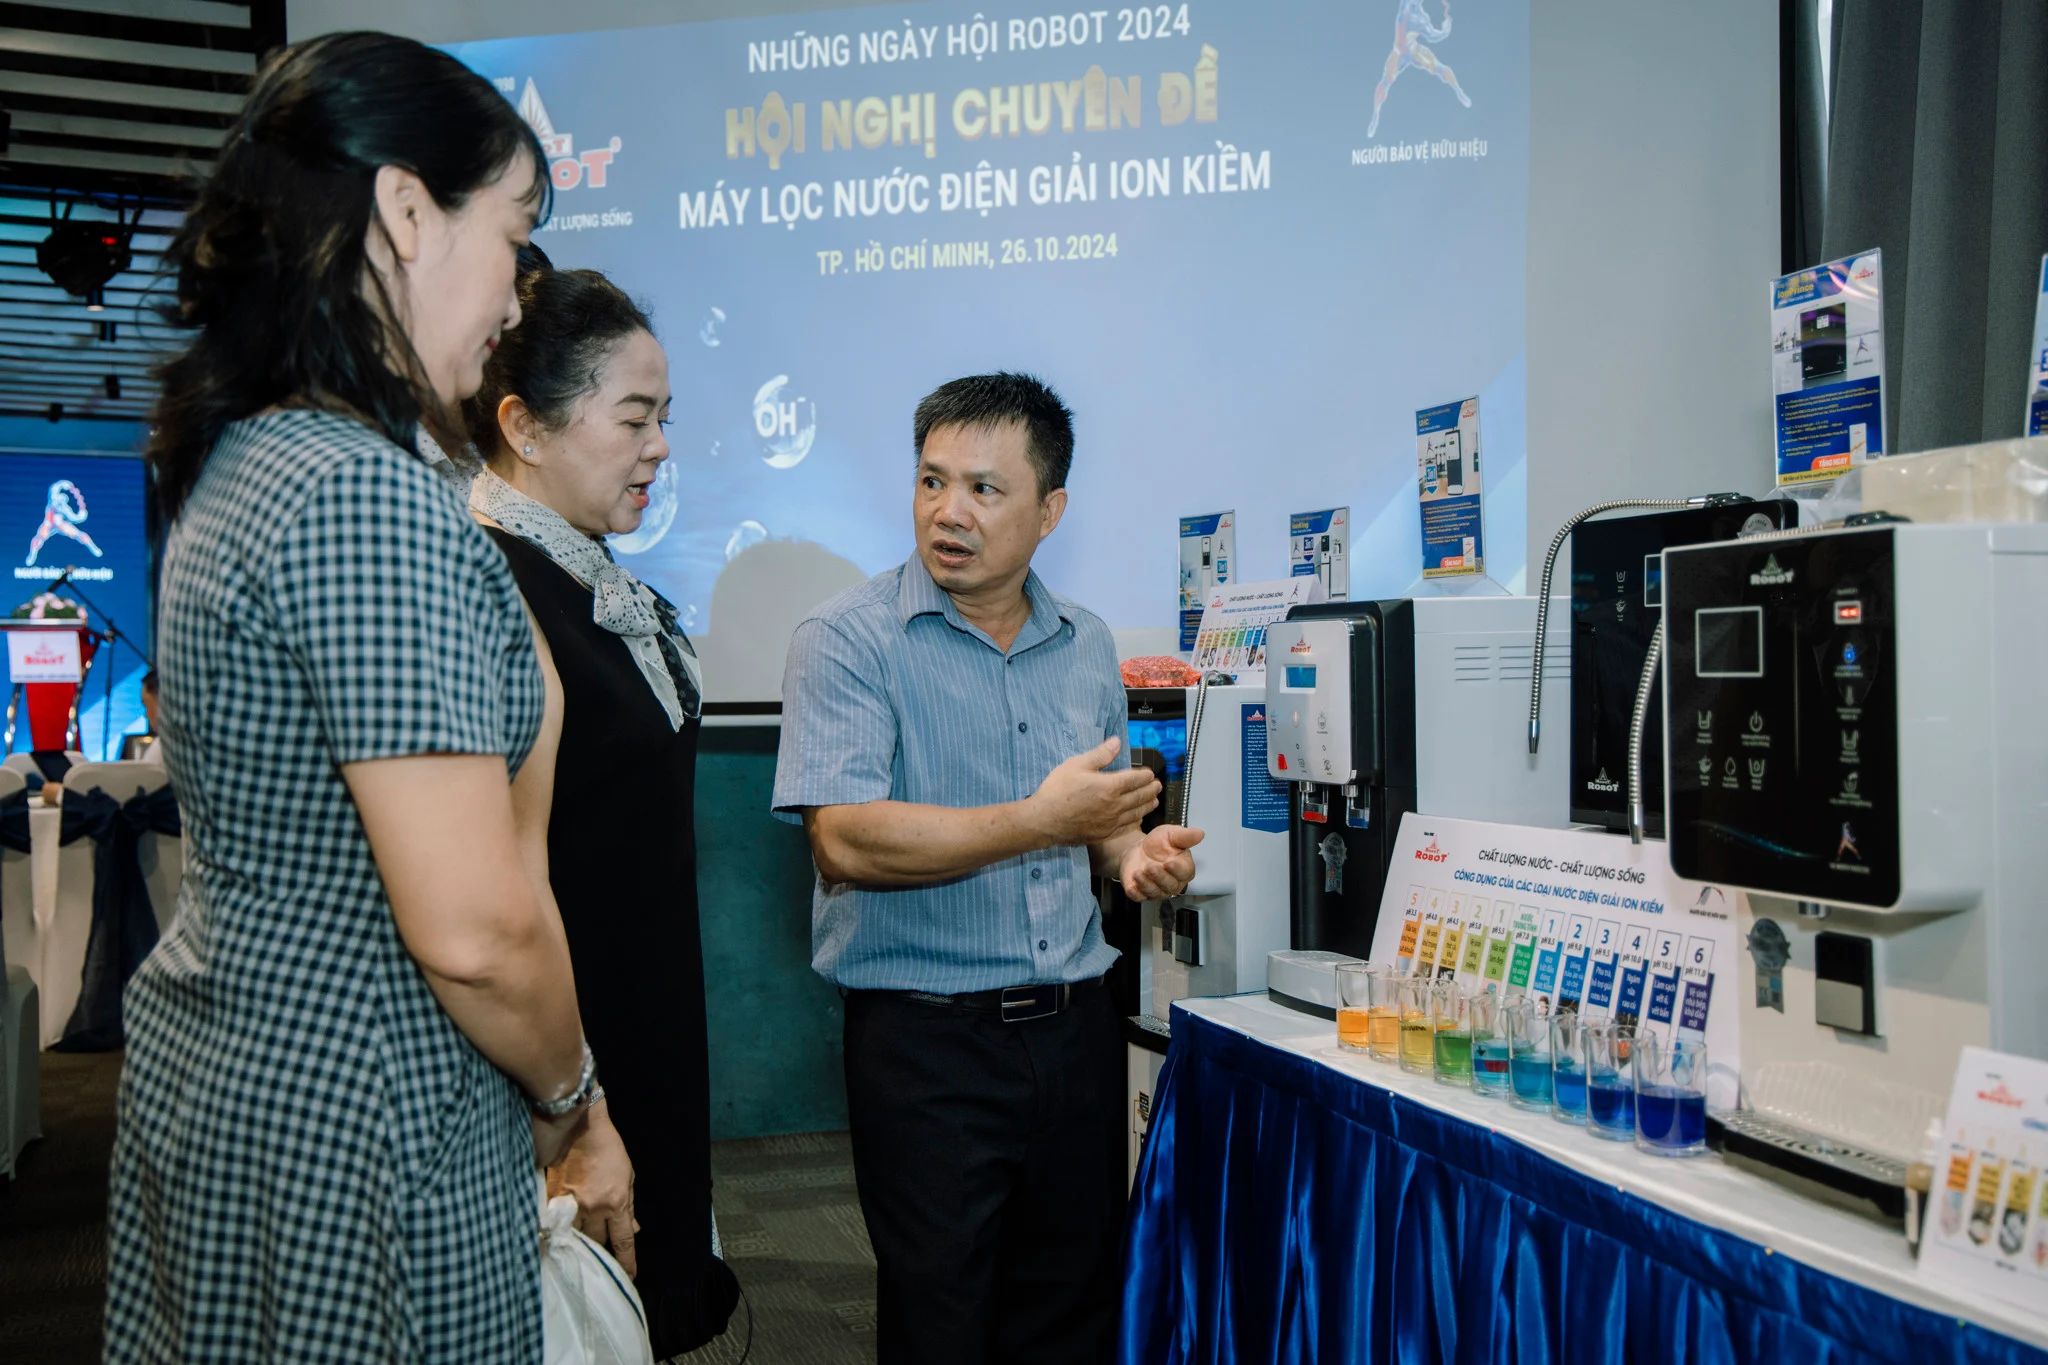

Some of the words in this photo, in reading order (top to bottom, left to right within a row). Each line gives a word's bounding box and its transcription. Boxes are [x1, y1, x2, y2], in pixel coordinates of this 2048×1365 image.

[748, 30, 850, 73] NHỮNG
[859, 19, 938, 63] NGÀY
[947, 13, 997, 61] HỘI
[1008, 11, 1107, 51] ROBOT
[1117, 3, 1191, 42] 2024
[725, 91, 806, 170] HỘI
[821, 92, 936, 158] NGHỊ
[952, 65, 1141, 141] CHUYÊN
[1157, 43, 1219, 123] ĐỀ
[1352, 144, 1388, 165] NGƯỜI
[1390, 140, 1413, 162] BẢO
[1414, 140, 1429, 164] VỆ
[1432, 138, 1457, 158] HỮU
[1460, 137, 1487, 161] HIỆU
[679, 180, 752, 229] MÁY
[761, 182, 824, 230] LỌC
[834, 167, 929, 218] NƯỚC
[939, 160, 1017, 217] ĐIỆN
[1029, 151, 1097, 205] GIẢI
[1110, 158, 1170, 200] ION
[1184, 140, 1271, 194] KIỀM
[561, 213, 599, 232] LƯỢNG
[601, 206, 633, 227] SỐNG
[817, 249, 849, 276] TP.
[855, 239, 885, 273] HỒ
[890, 239, 927, 270] CHÍ
[933, 242, 995, 271] MINH,
[1001, 233, 1118, 265] 26.10.2024
[1751, 573, 1792, 585] ROBOT
[1587, 782, 1619, 792] ROBOT
[1415, 850, 1447, 863] ROBOT
[1479, 848, 1499, 863] CHẤT
[1500, 853, 1526, 867] LƯỢNG
[1528, 857, 1553, 871] NƯỚC
[1560, 860, 1583, 876] CHẤT
[1584, 866, 1615, 882] LƯỢNG
[1617, 867, 1645, 884] SỐNG
[1411, 893, 1418, 905] 5
[1454, 868, 1475, 883] CÔNG
[1476, 873, 1497, 888] DỤNG
[1499, 875, 1514, 890] CỦA
[1516, 878, 1532, 892] CÁC
[1533, 883, 1551, 898] LOẠI
[1553, 885, 1577, 900] NƯỚC
[1579, 889, 1599, 905] ĐIỆN
[1600, 891, 1619, 908] GIẢI
[1621, 898, 1638, 911] ION
[1640, 897, 1664, 915] KIỀM
[1431, 897, 1438, 909] 4
[1452, 901, 1459, 914] 3
[1474, 905, 1482, 918] 2
[1499, 909, 1504, 923] 1
[1549, 919, 1554, 933] 1
[1573, 924, 1582, 939] 2
[1601, 929, 1610, 944] 3
[1632, 935, 1641, 950] 4
[1661, 941, 1670, 956] 5
[1694, 948, 1704, 963] 6
